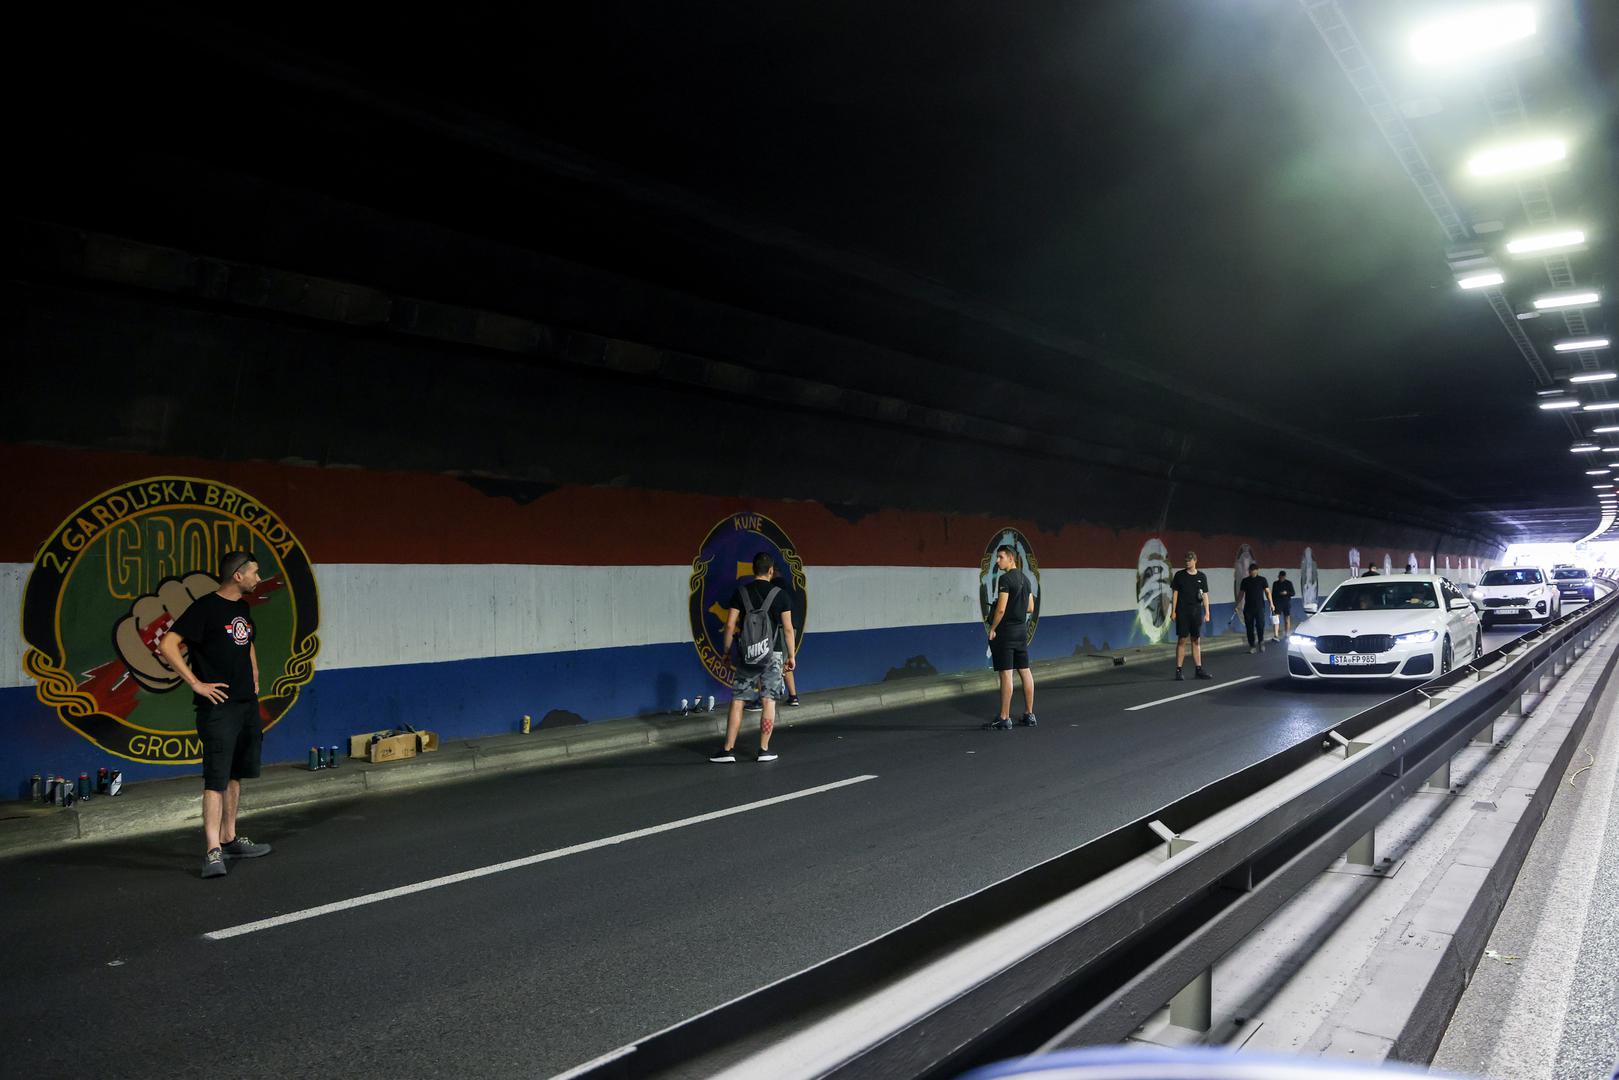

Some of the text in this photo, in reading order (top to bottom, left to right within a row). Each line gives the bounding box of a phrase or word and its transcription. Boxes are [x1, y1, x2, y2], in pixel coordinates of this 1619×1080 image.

[42, 551, 71, 574] 2.
[204, 484, 295, 560] BRIGADA
[735, 515, 762, 531] KUNE
[747, 637, 769, 659] NIKE
[128, 734, 204, 758] GROM
